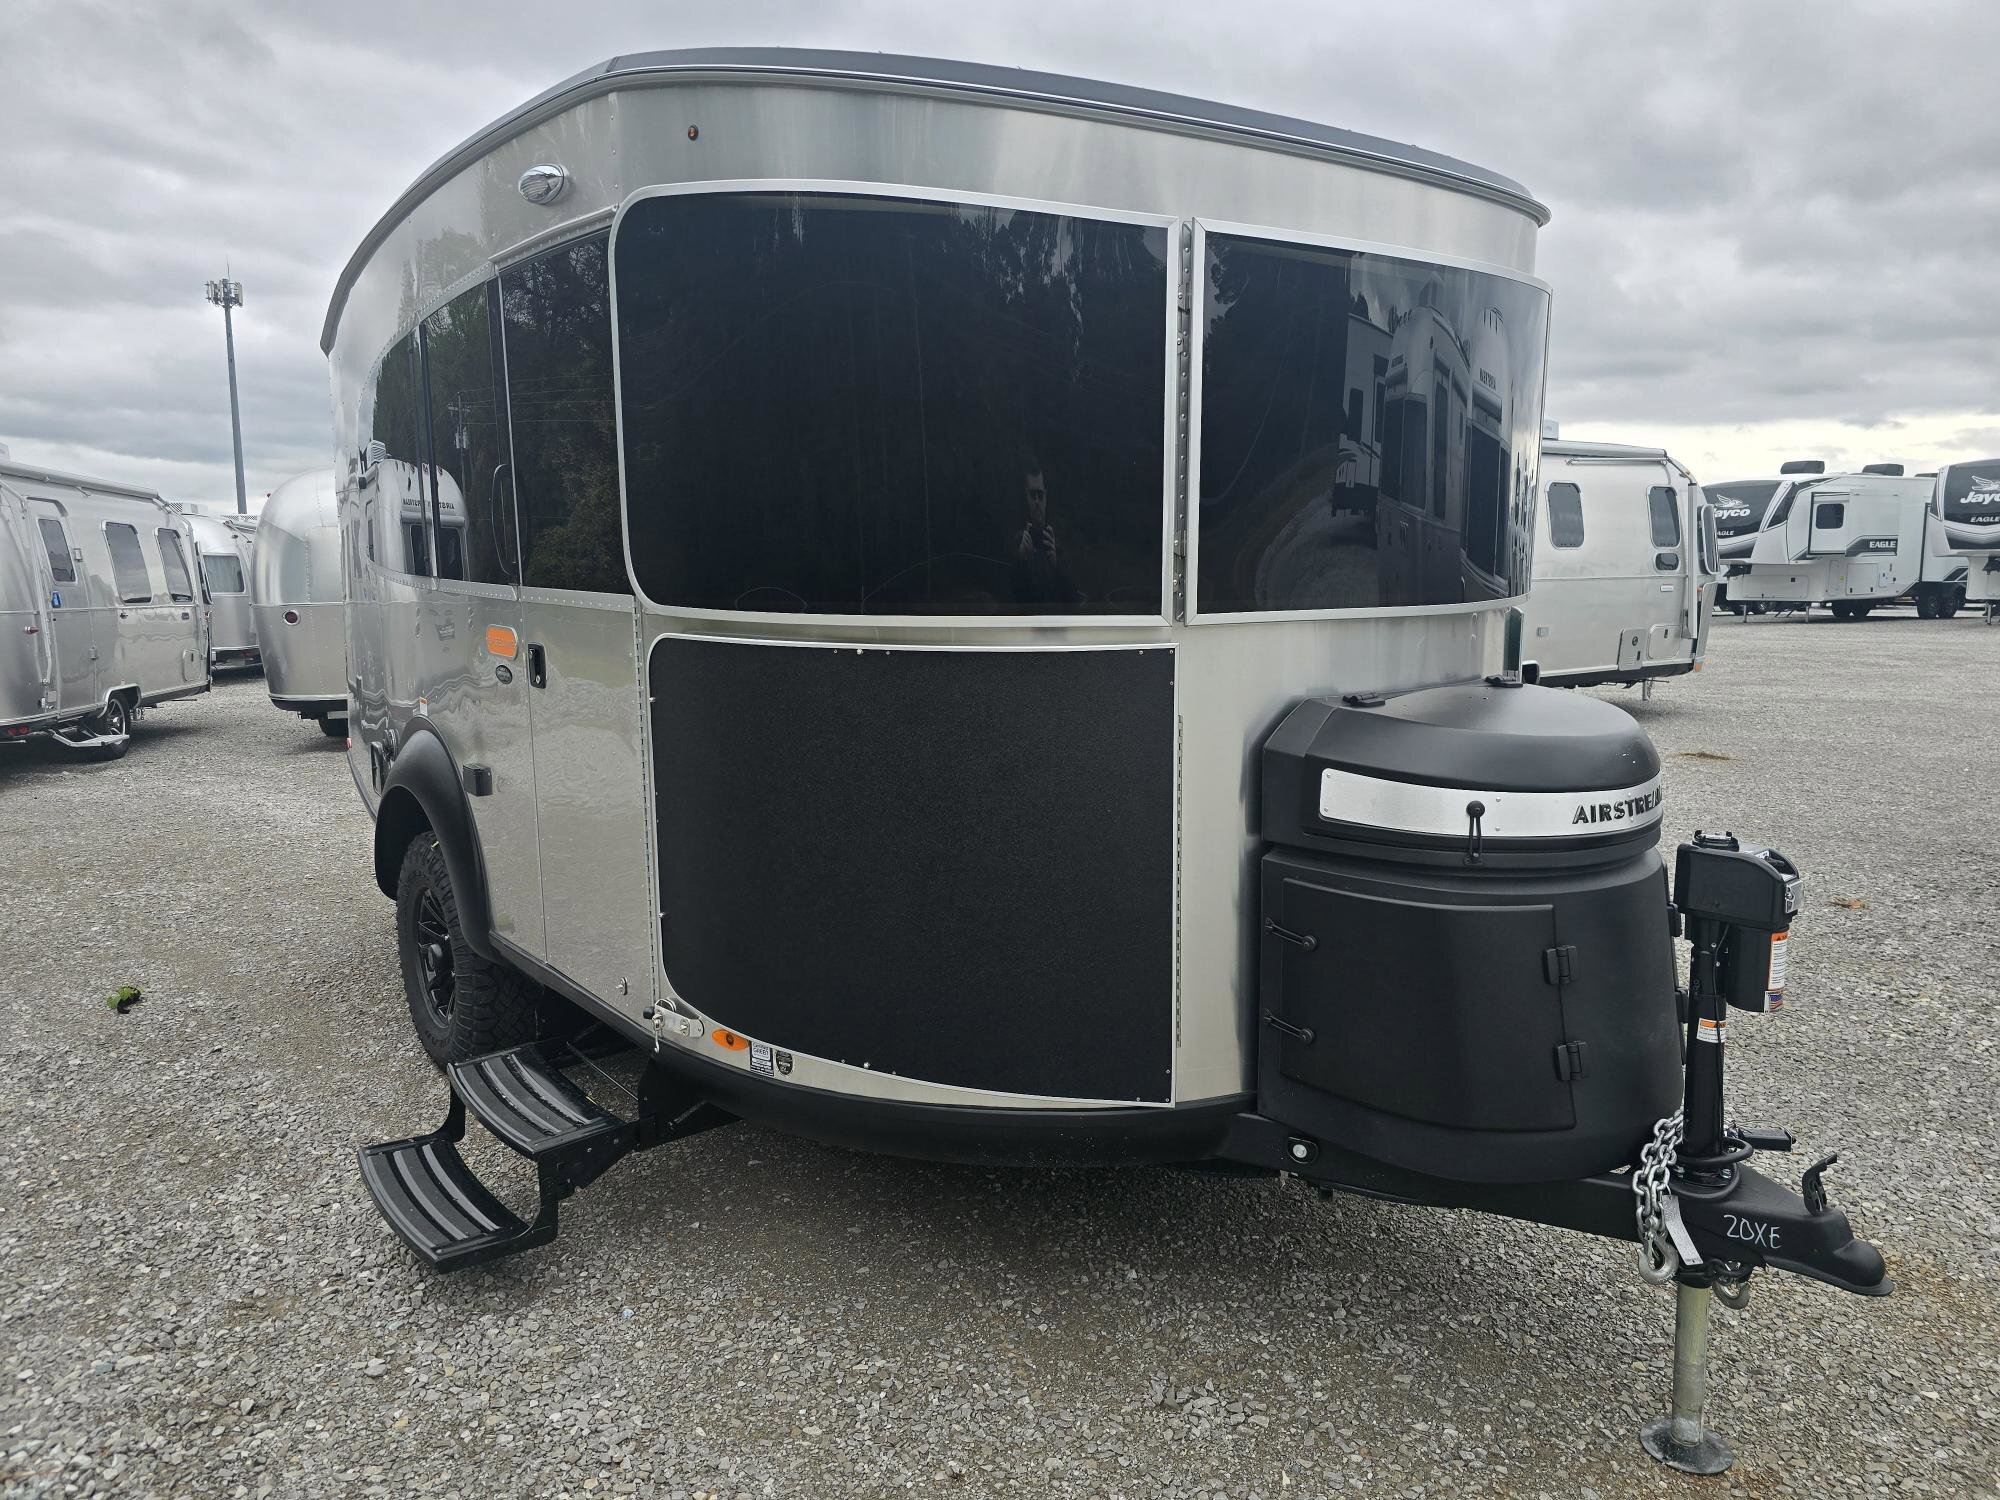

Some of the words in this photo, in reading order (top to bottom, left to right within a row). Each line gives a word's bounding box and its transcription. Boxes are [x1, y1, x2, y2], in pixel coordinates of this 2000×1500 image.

[1960, 492, 2000, 504] Jayc
[1714, 509, 1751, 520] ayco
[1869, 540, 1897, 549] EAGLE
[1723, 1214, 1782, 1249] 20XE
